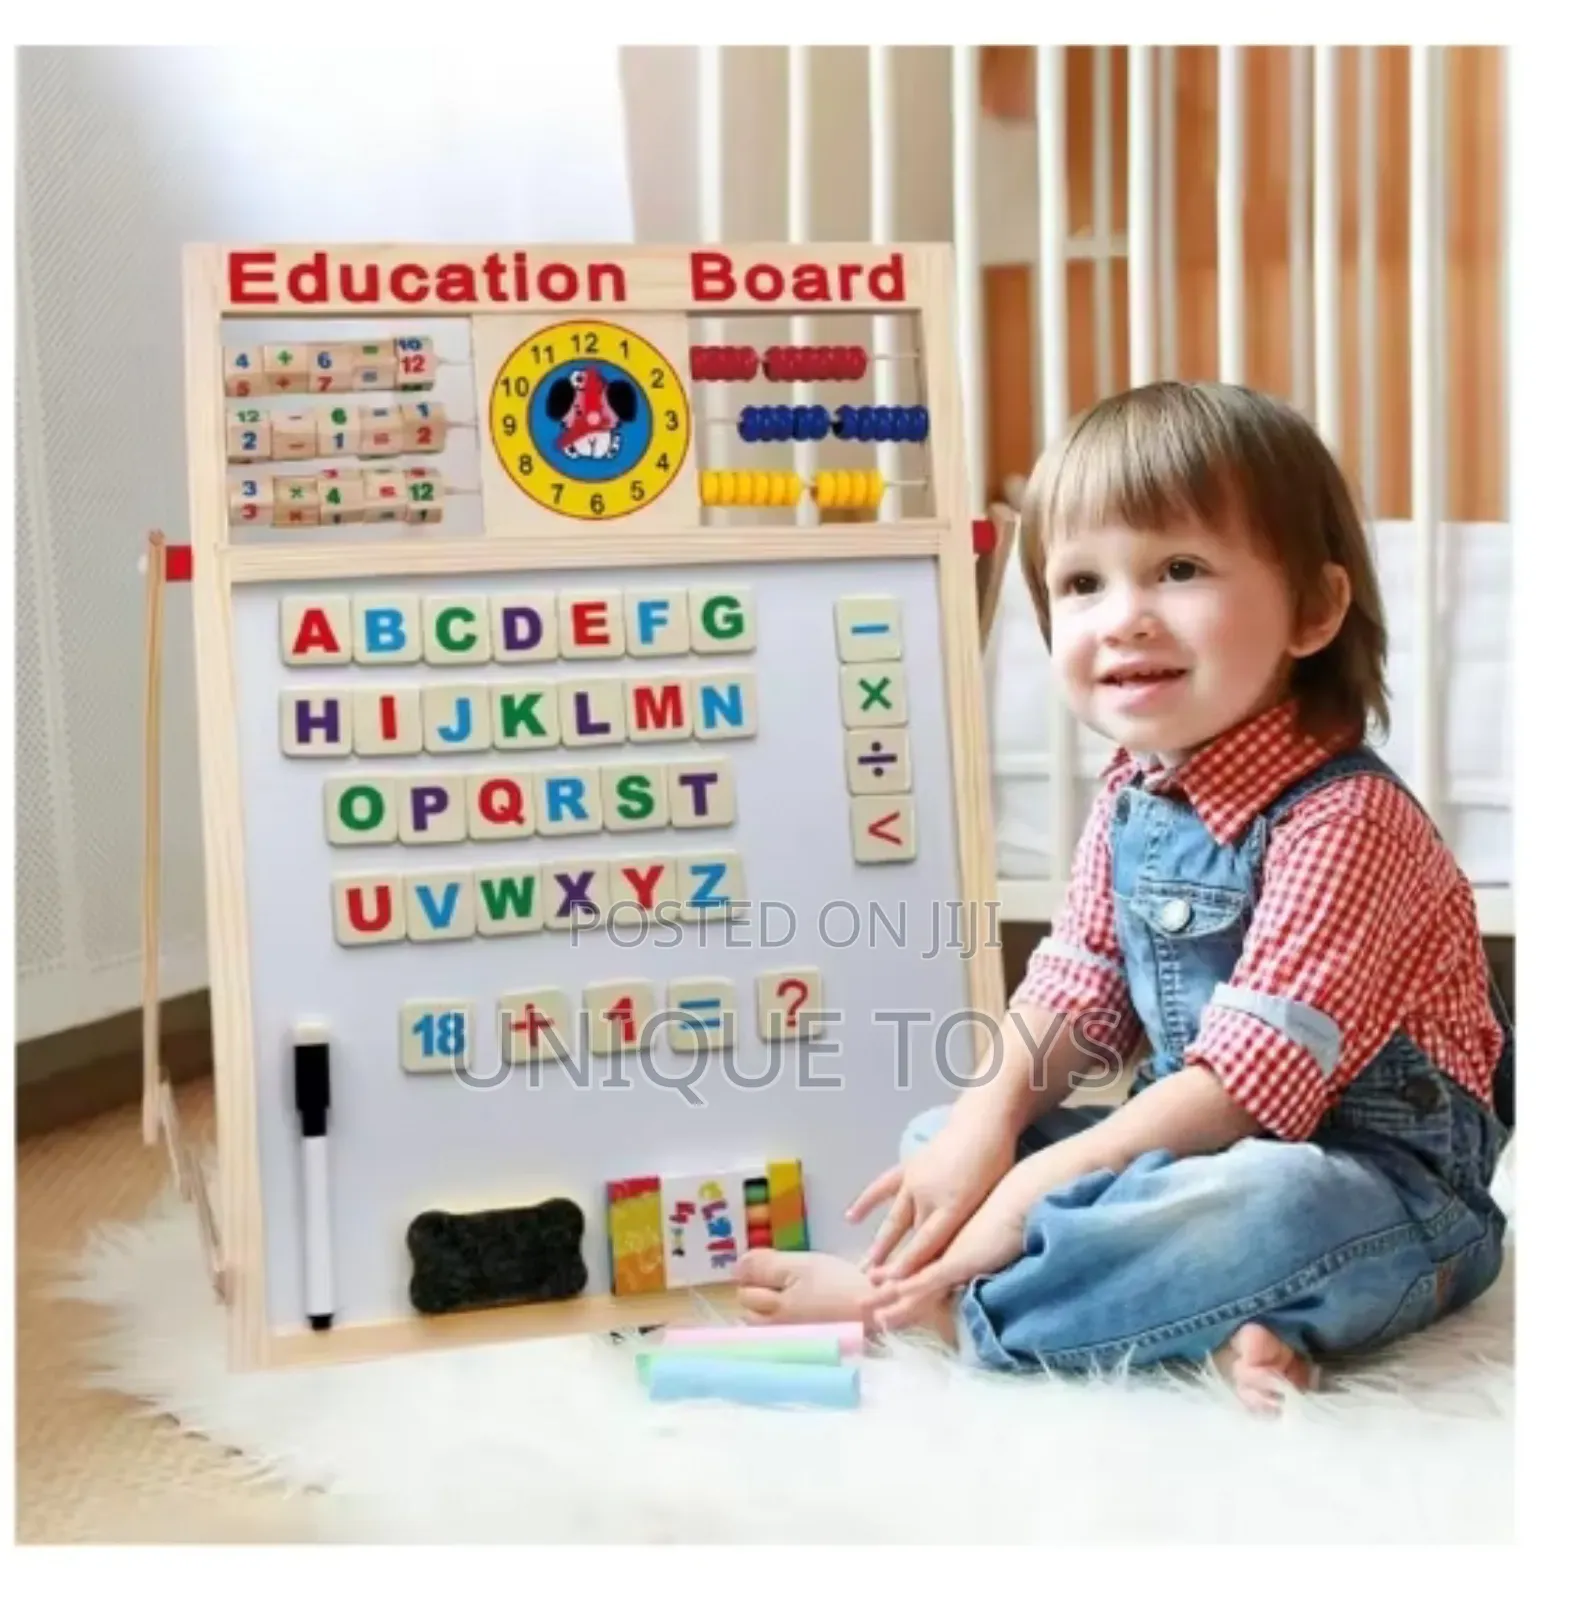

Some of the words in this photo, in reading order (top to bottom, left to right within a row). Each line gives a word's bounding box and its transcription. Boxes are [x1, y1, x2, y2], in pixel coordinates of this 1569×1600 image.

[229, 251, 626, 304] Education
[690, 252, 905, 302] Board
[570, 332, 598, 353] 12
[620, 340, 630, 359] 1
[235, 352, 250, 370] 4
[316, 350, 332, 370] 6
[531, 345, 555, 364] 11
[317, 375, 334, 393] 7
[400, 354, 426, 375] 12
[651, 368, 665, 388] 2
[501, 376, 529, 397] 10
[237, 409, 261, 424] 12
[502, 414, 517, 436] 9
[665, 410, 679, 431] 3
[241, 431, 257, 451] 2
[331, 432, 345, 451] 1
[416, 425, 433, 446] 2
[518, 454, 533, 475] 8
[656, 453, 670, 471] 4
[241, 479, 258, 497] 3
[324, 485, 343, 506] 4
[408, 481, 435, 502] 12
[550, 483, 565, 504] 7
[630, 480, 645, 501] 5
[590, 494, 605, 514] 6
[412, 1011, 467, 1058] 18
[607, 996, 637, 1042] 1
[775, 978, 809, 1029] ?
